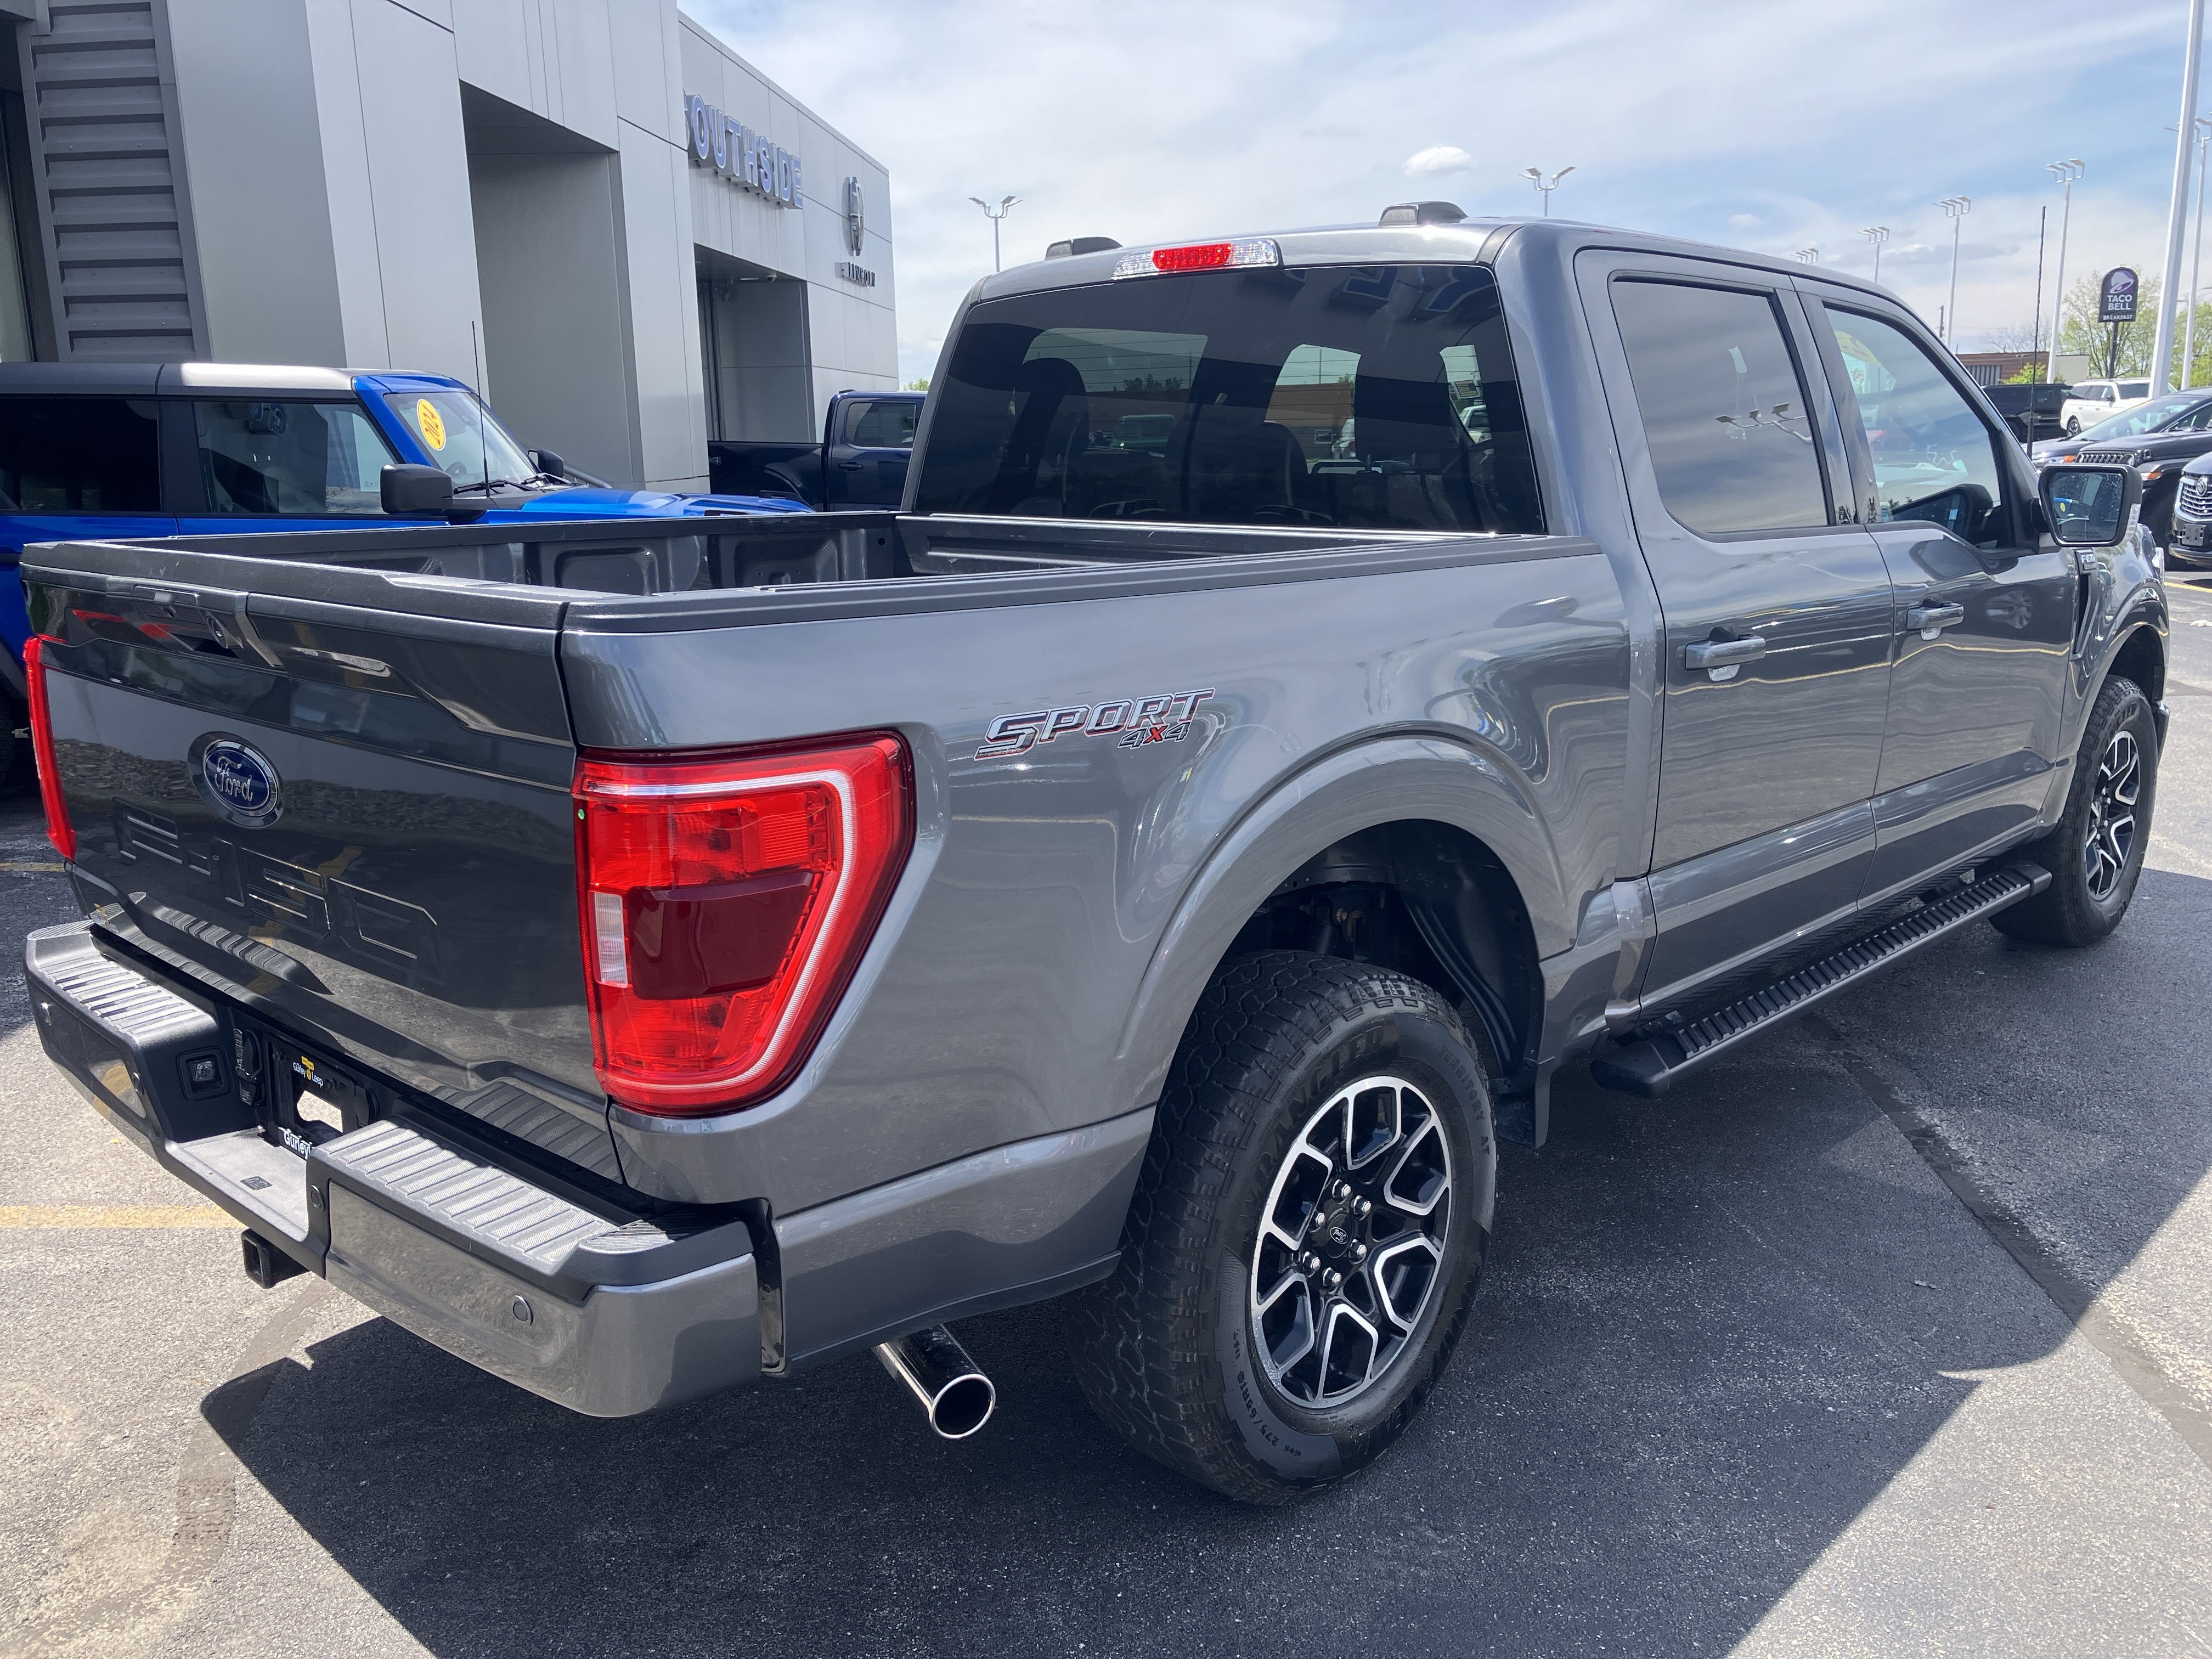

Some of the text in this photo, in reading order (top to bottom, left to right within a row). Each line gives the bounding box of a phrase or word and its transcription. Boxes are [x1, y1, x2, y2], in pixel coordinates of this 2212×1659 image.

[685, 93, 803, 209] OUTHSIDE
[974, 687, 1216, 761] SPORT
[216, 756, 254, 802] Ford
[292, 1062, 306, 1078] Gurley
[1438, 1045, 1489, 1155] TERRITORY AT
[1333, 1229, 1347, 1243] Ford
